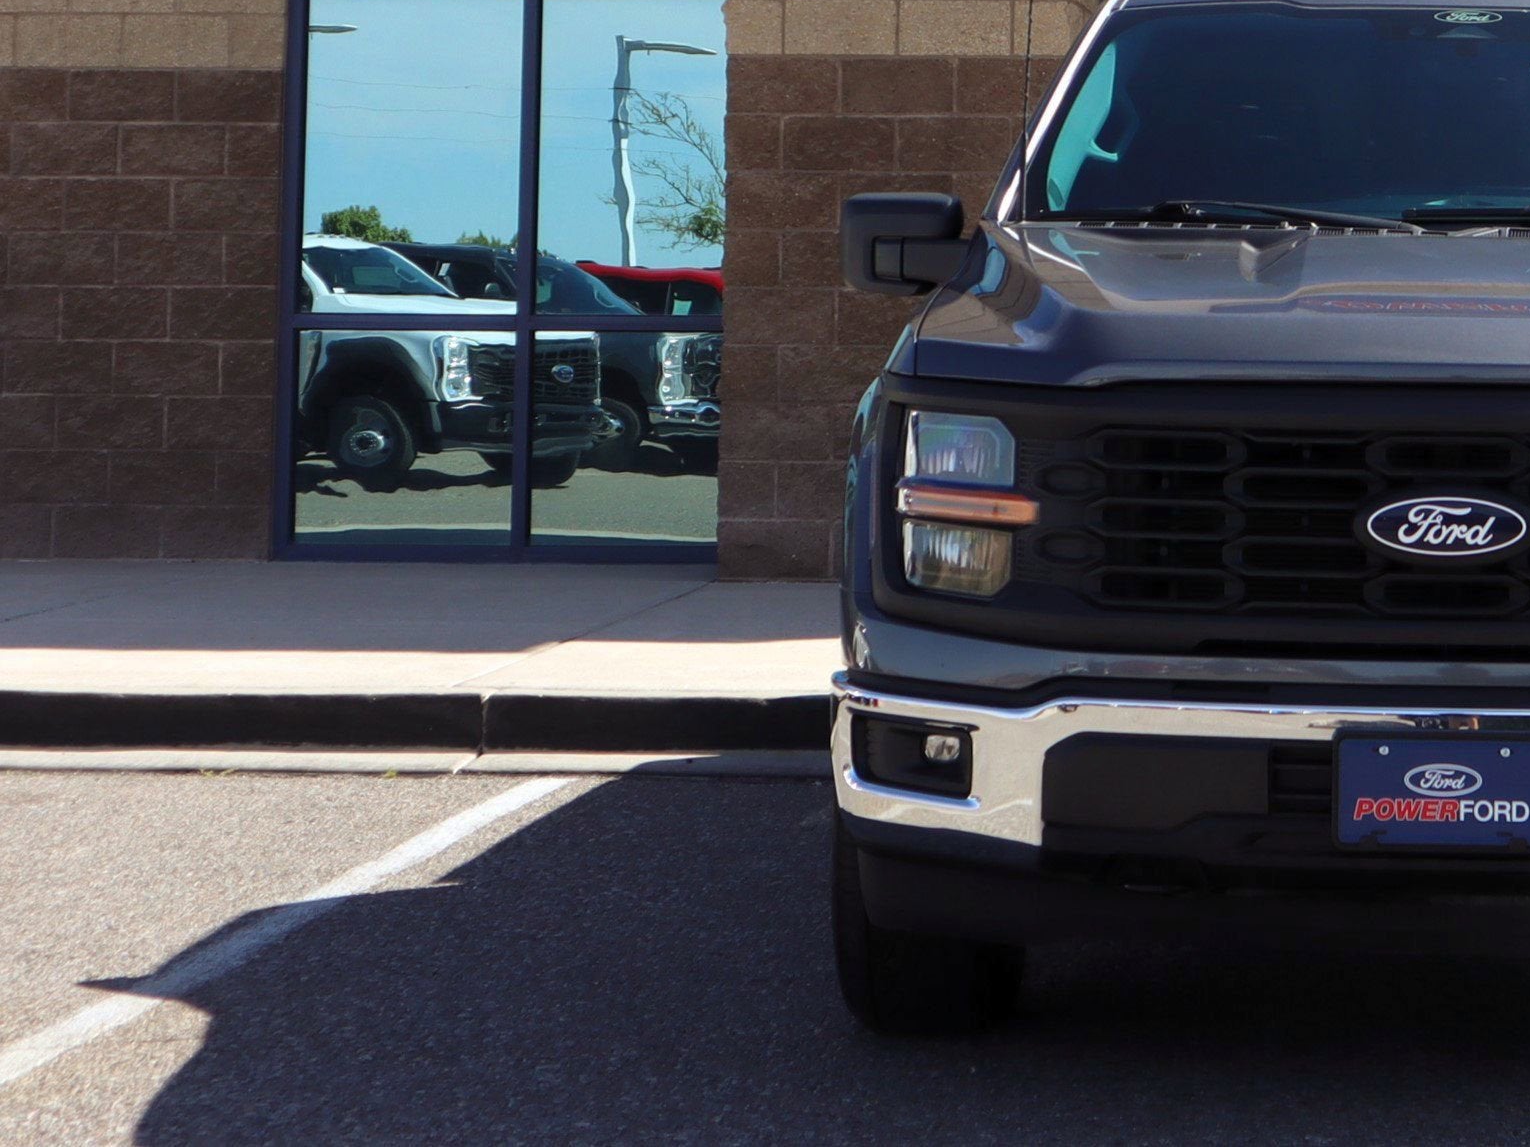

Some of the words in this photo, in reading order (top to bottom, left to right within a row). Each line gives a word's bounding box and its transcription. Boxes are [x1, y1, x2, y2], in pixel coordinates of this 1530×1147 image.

[1446, 11, 1490, 22] Ford
[1397, 504, 1497, 547] Ford
[1420, 769, 1466, 790] Ford
